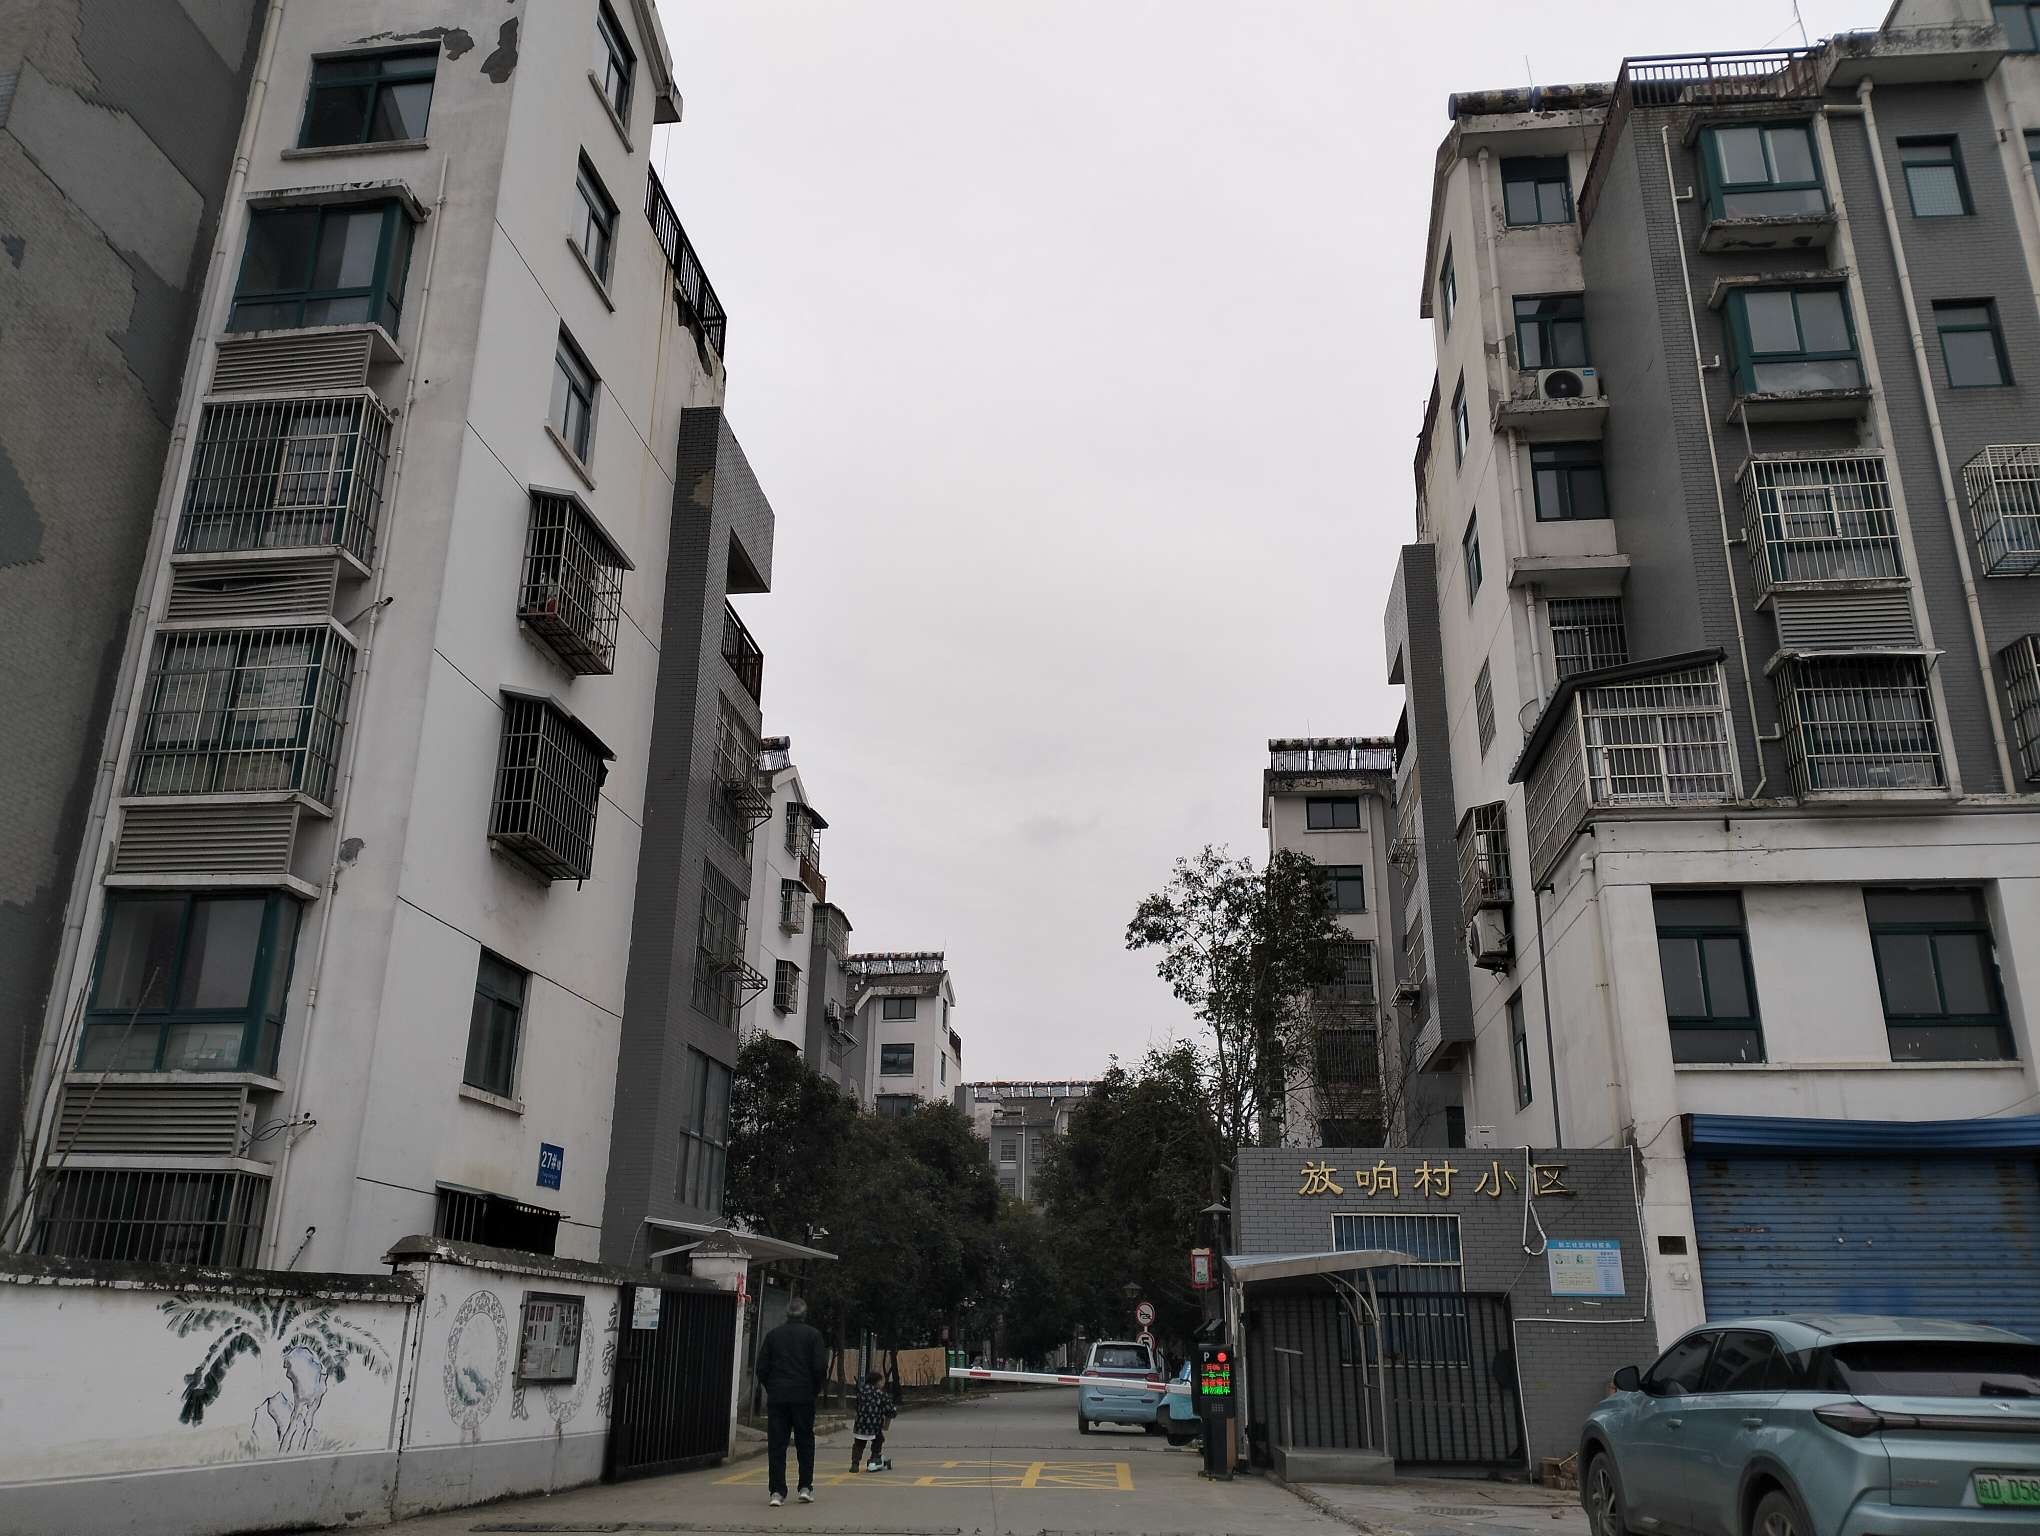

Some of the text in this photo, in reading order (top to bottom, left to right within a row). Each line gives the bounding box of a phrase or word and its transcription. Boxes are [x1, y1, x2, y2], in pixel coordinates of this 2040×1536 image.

[1299, 1160, 1577, 1197] 放响村小区
[1203, 1352, 1210, 1362] P
